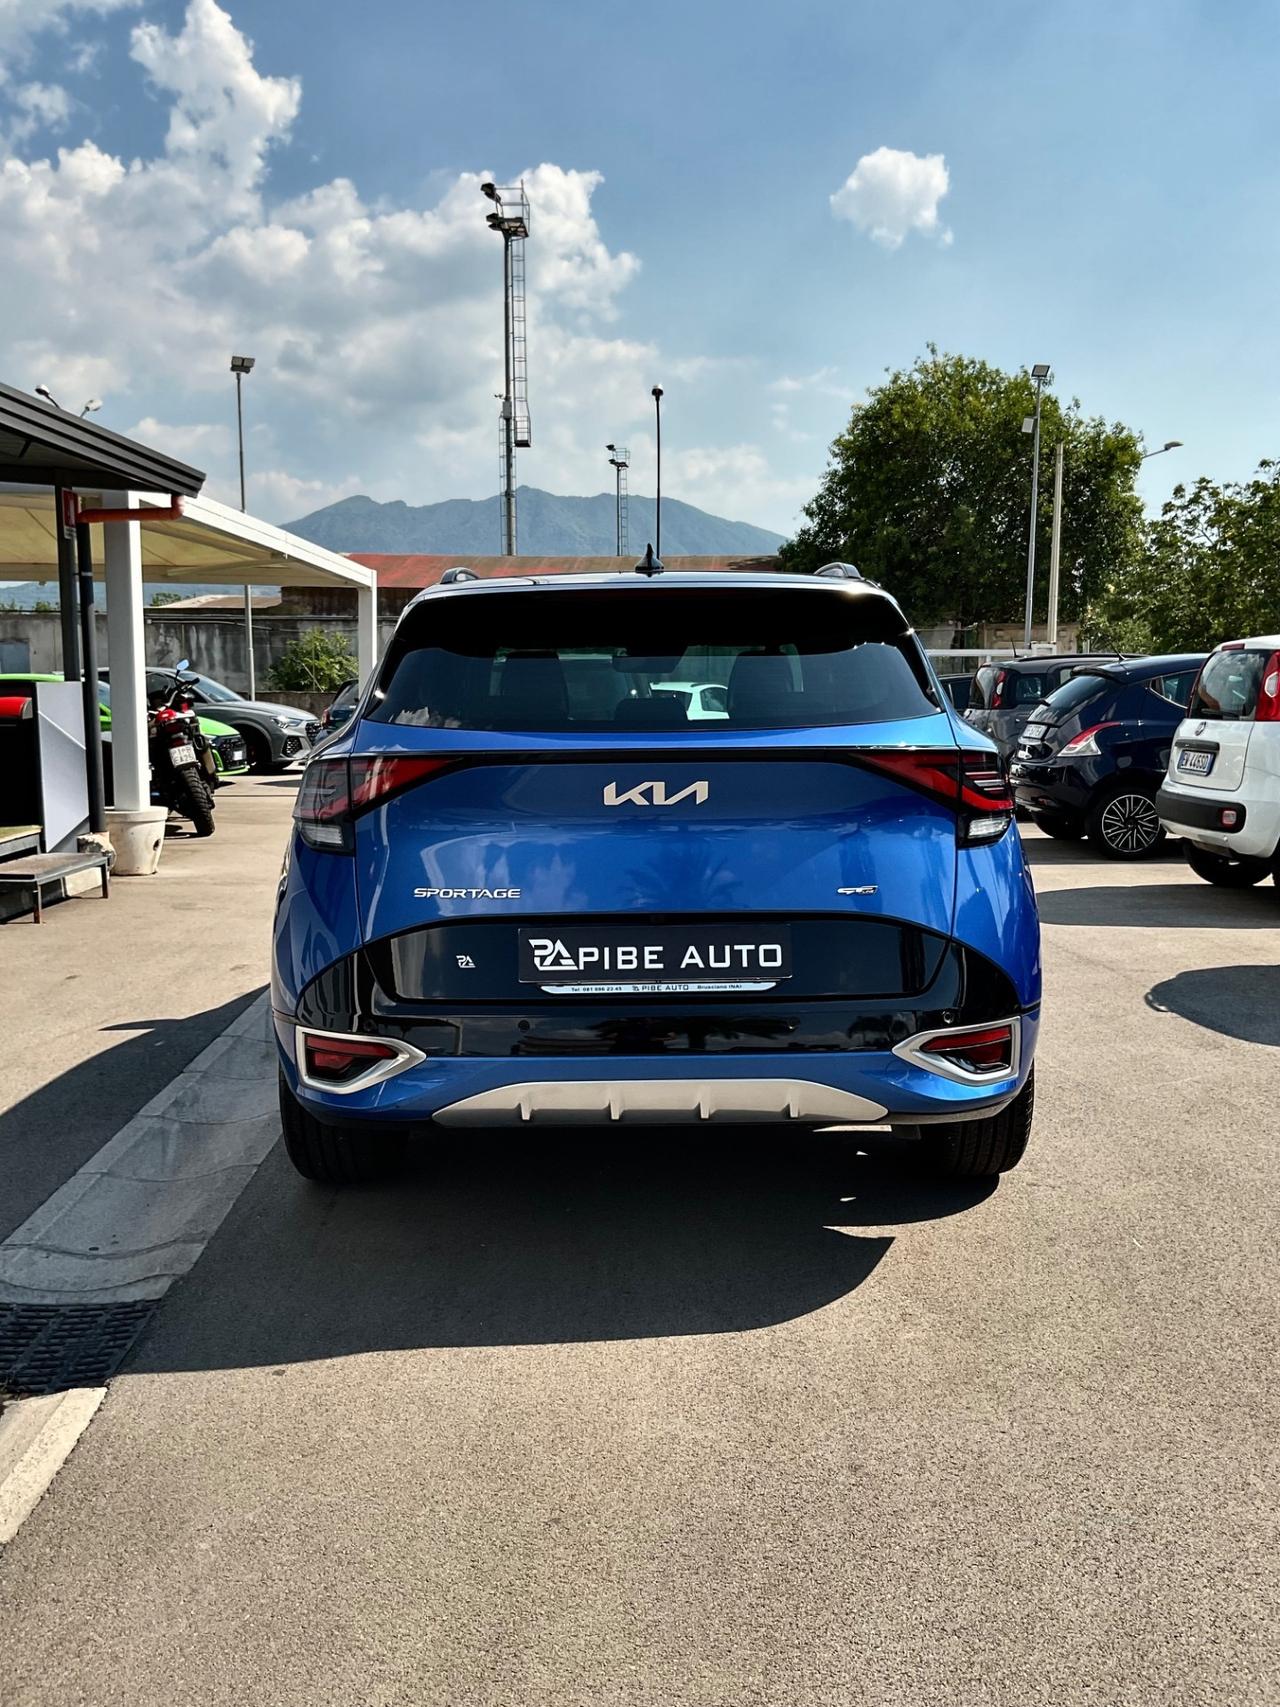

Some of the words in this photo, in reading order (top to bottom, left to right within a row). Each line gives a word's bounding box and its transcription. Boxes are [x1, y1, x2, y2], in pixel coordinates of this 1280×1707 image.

[414, 888, 522, 899] SPORTAGE
[578, 946, 664, 971] PIBE
[680, 944, 783, 969] AUTO
